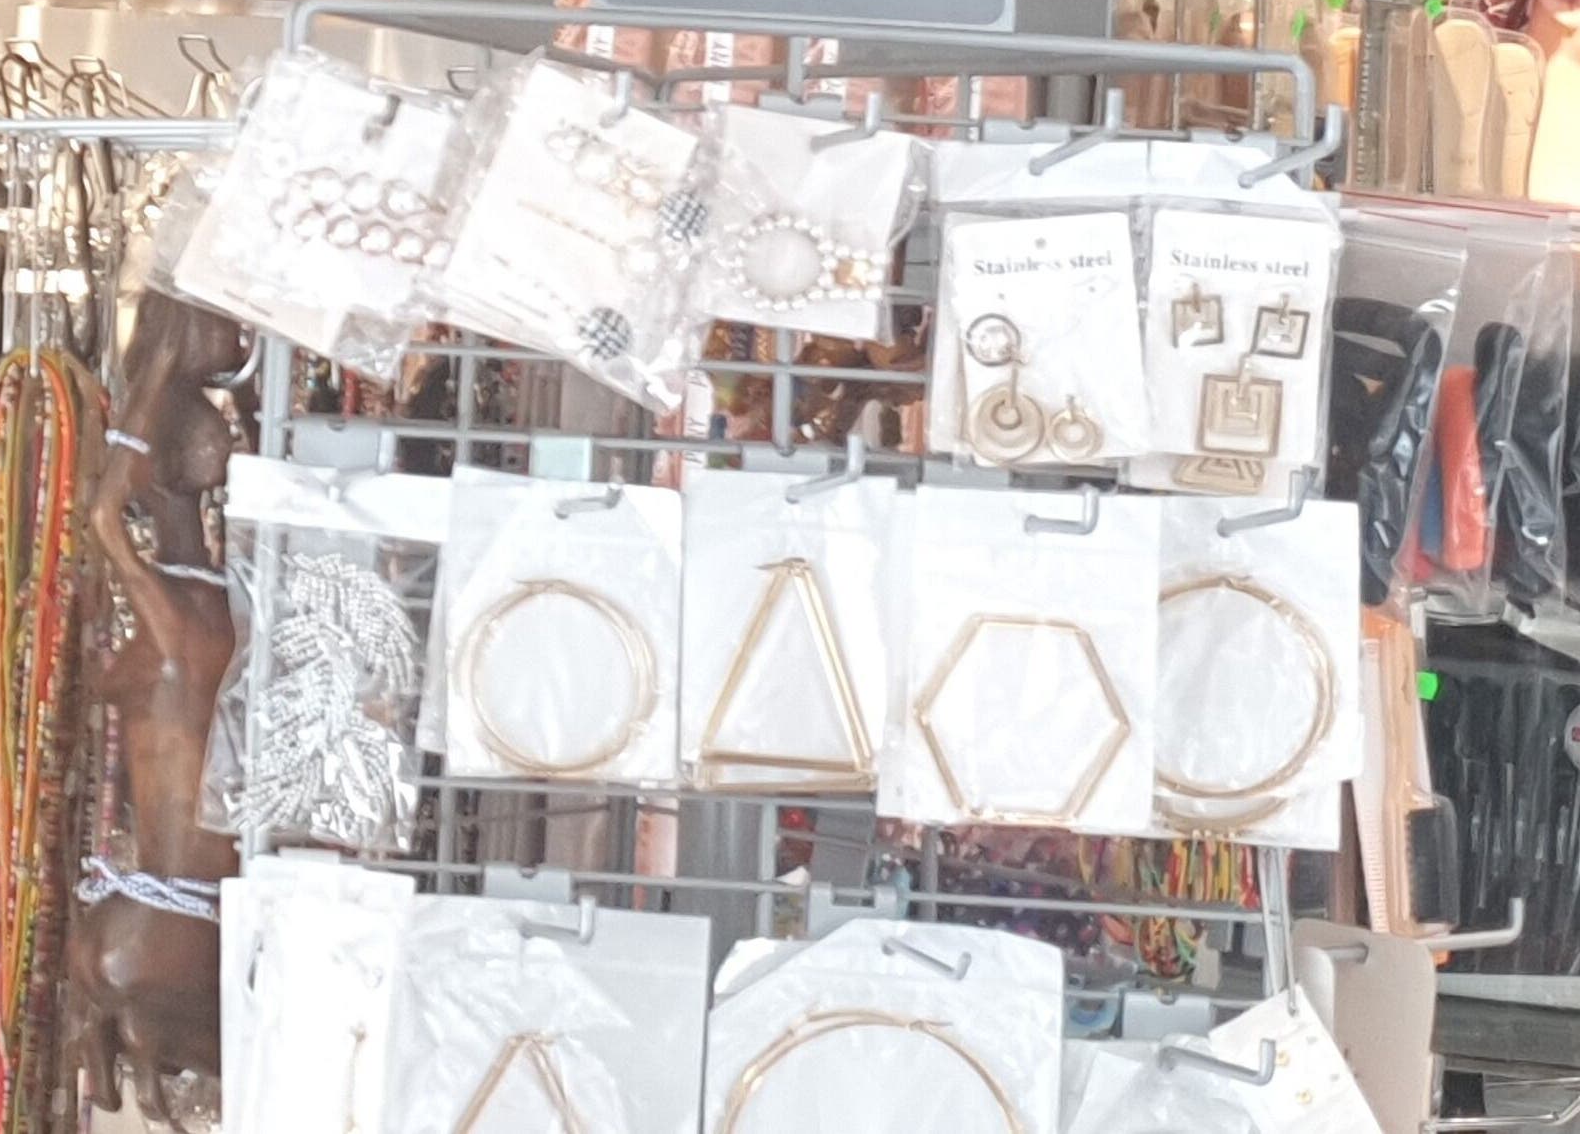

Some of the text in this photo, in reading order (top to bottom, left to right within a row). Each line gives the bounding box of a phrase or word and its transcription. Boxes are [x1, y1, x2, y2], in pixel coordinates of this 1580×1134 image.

[1069, 249, 1113, 268] steel
[1170, 248, 1309, 278] Stainless steel
